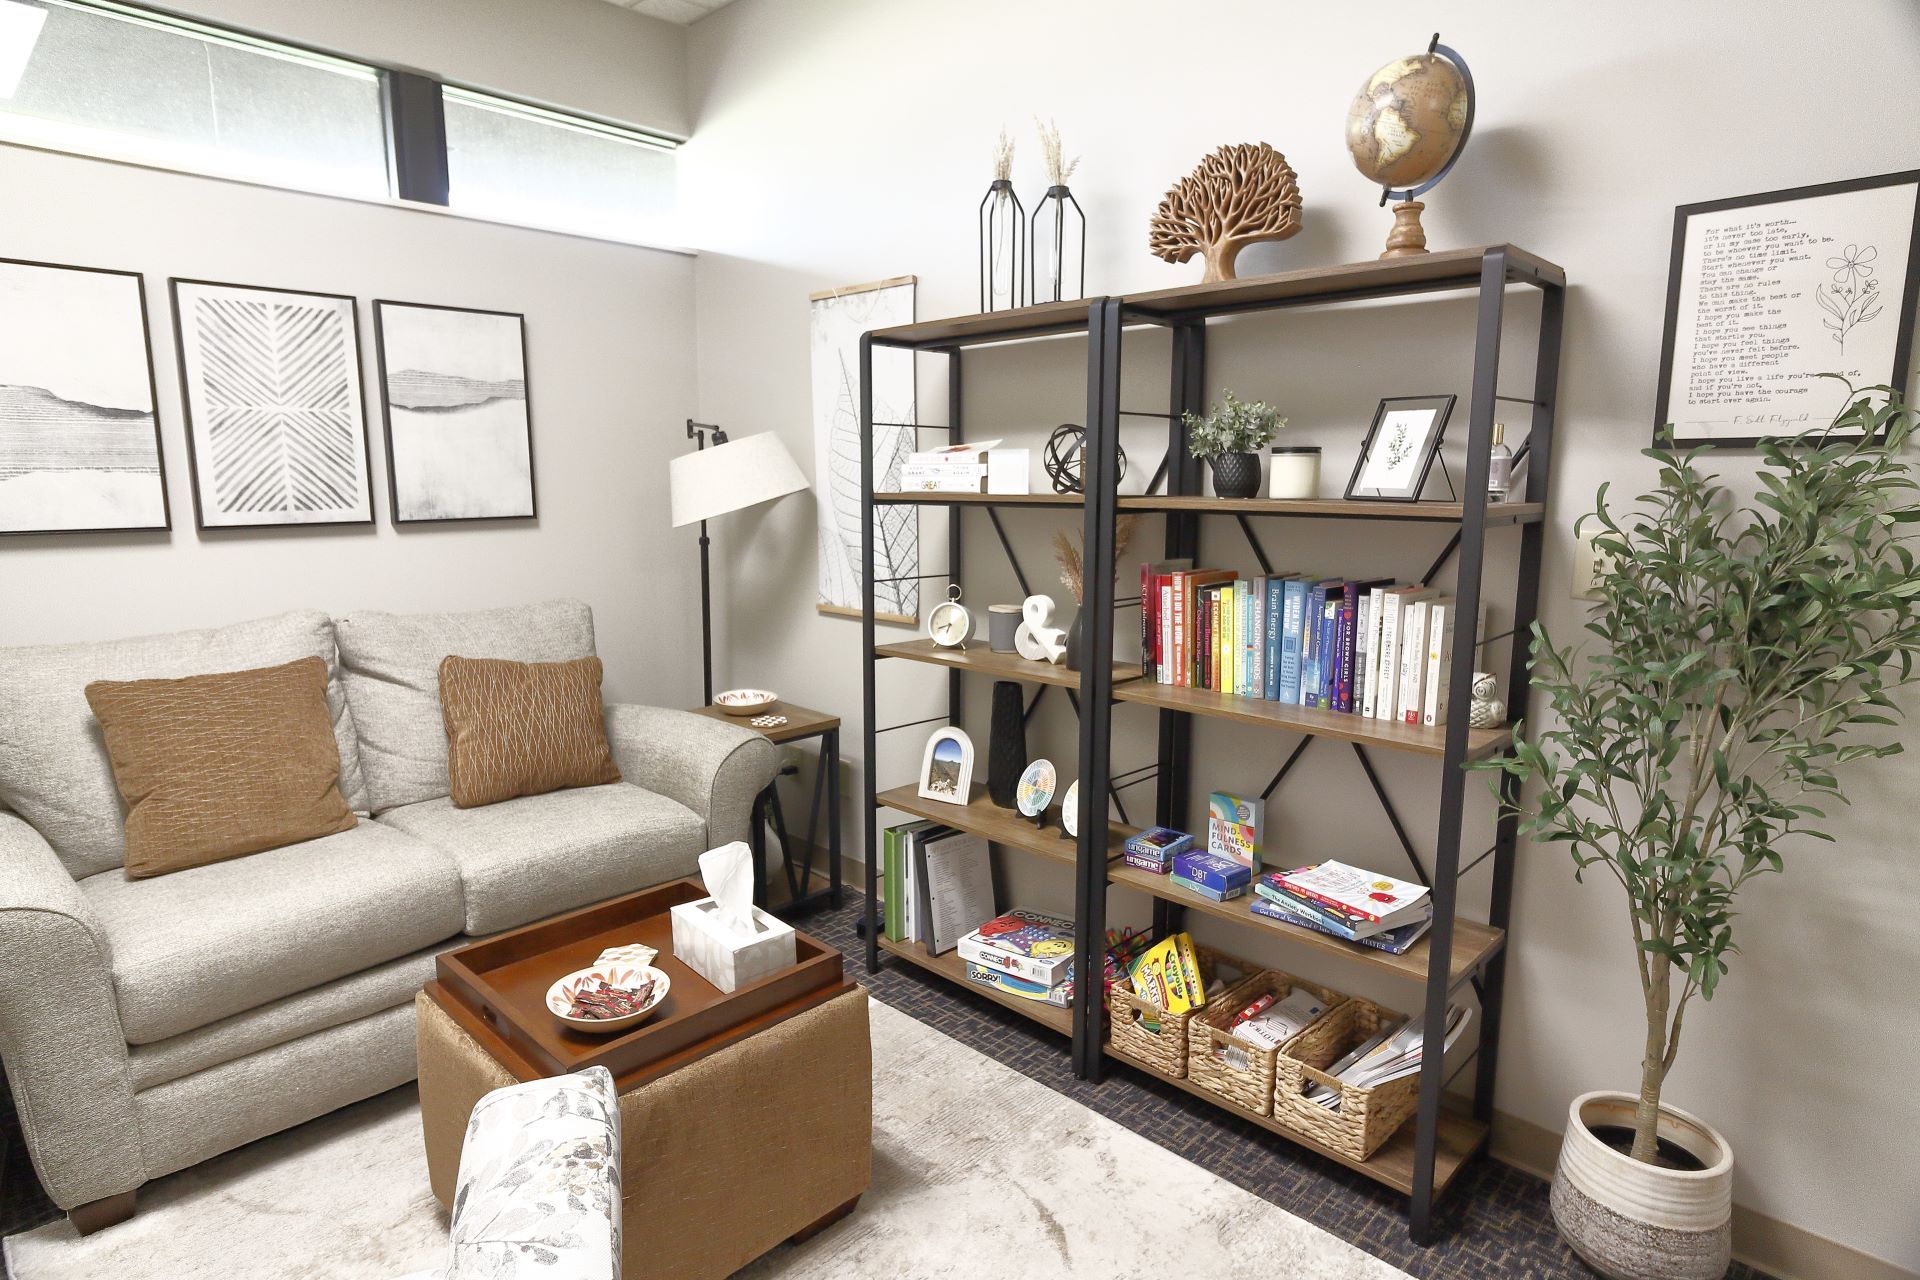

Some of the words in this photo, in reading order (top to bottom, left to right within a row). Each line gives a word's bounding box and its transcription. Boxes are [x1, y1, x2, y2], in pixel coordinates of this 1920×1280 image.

[1174, 576, 1182, 592] HOW
[1174, 592, 1182, 601] TO
[1270, 588, 1280, 610] Brain
[1284, 599, 1292, 630] WINDOW
[1292, 596, 1300, 619] WIDEN
[1174, 613, 1183, 626] THE
[1212, 602, 1220, 632] ECKHART
[1254, 600, 1262, 649] CHANGING
[1268, 612, 1279, 641] Energy
[1291, 621, 1300, 635] THE
[1344, 622, 1352, 635] FOR
[1174, 626, 1183, 646] WORK
[1254, 651, 1262, 680] MINDS
[1212, 822, 1240, 836] MIND-
[1211, 832, 1251, 849] FULNESS
[1128, 842, 1160, 858] ungame
[1211, 842, 1242, 856] CARDS
[1126, 855, 1159, 870] ungame
[1192, 866, 1208, 881] DBT
[1272, 894, 1281, 904] The
[1281, 898, 1300, 914] Anxiety
[1300, 908, 1325, 924] Workbook
[1270, 910, 1280, 920] Out
[1286, 914, 1298, 926] Your
[1362, 938, 1387, 951] HAYES
[980, 951, 1004, 964] CONNECT
[971, 970, 1002, 984] SORRY!
[1168, 952, 1184, 995] Crayola
